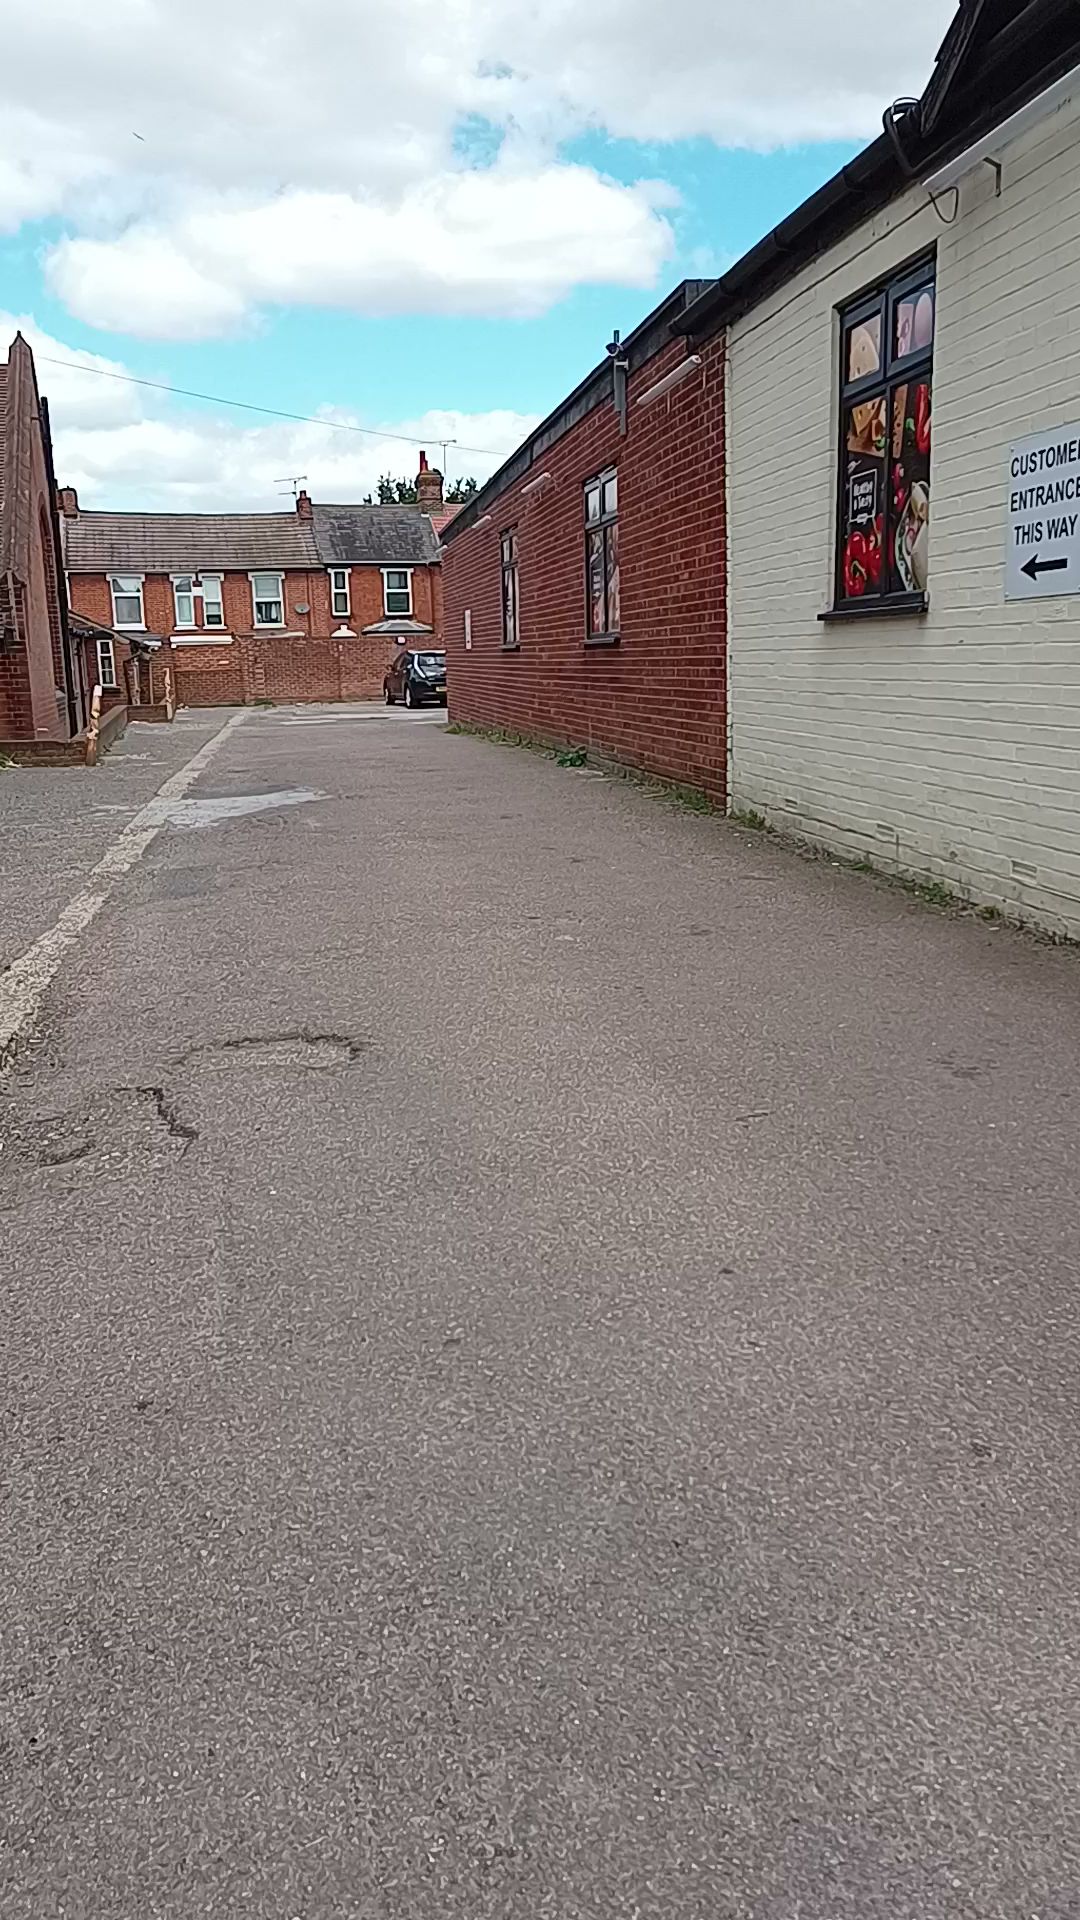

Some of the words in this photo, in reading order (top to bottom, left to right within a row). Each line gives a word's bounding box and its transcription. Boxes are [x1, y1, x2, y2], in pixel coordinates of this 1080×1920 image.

[1011, 439, 1080, 478] CUSTOME
[1014, 521, 1043, 545] THIS
[1047, 513, 1079, 540] WAY
